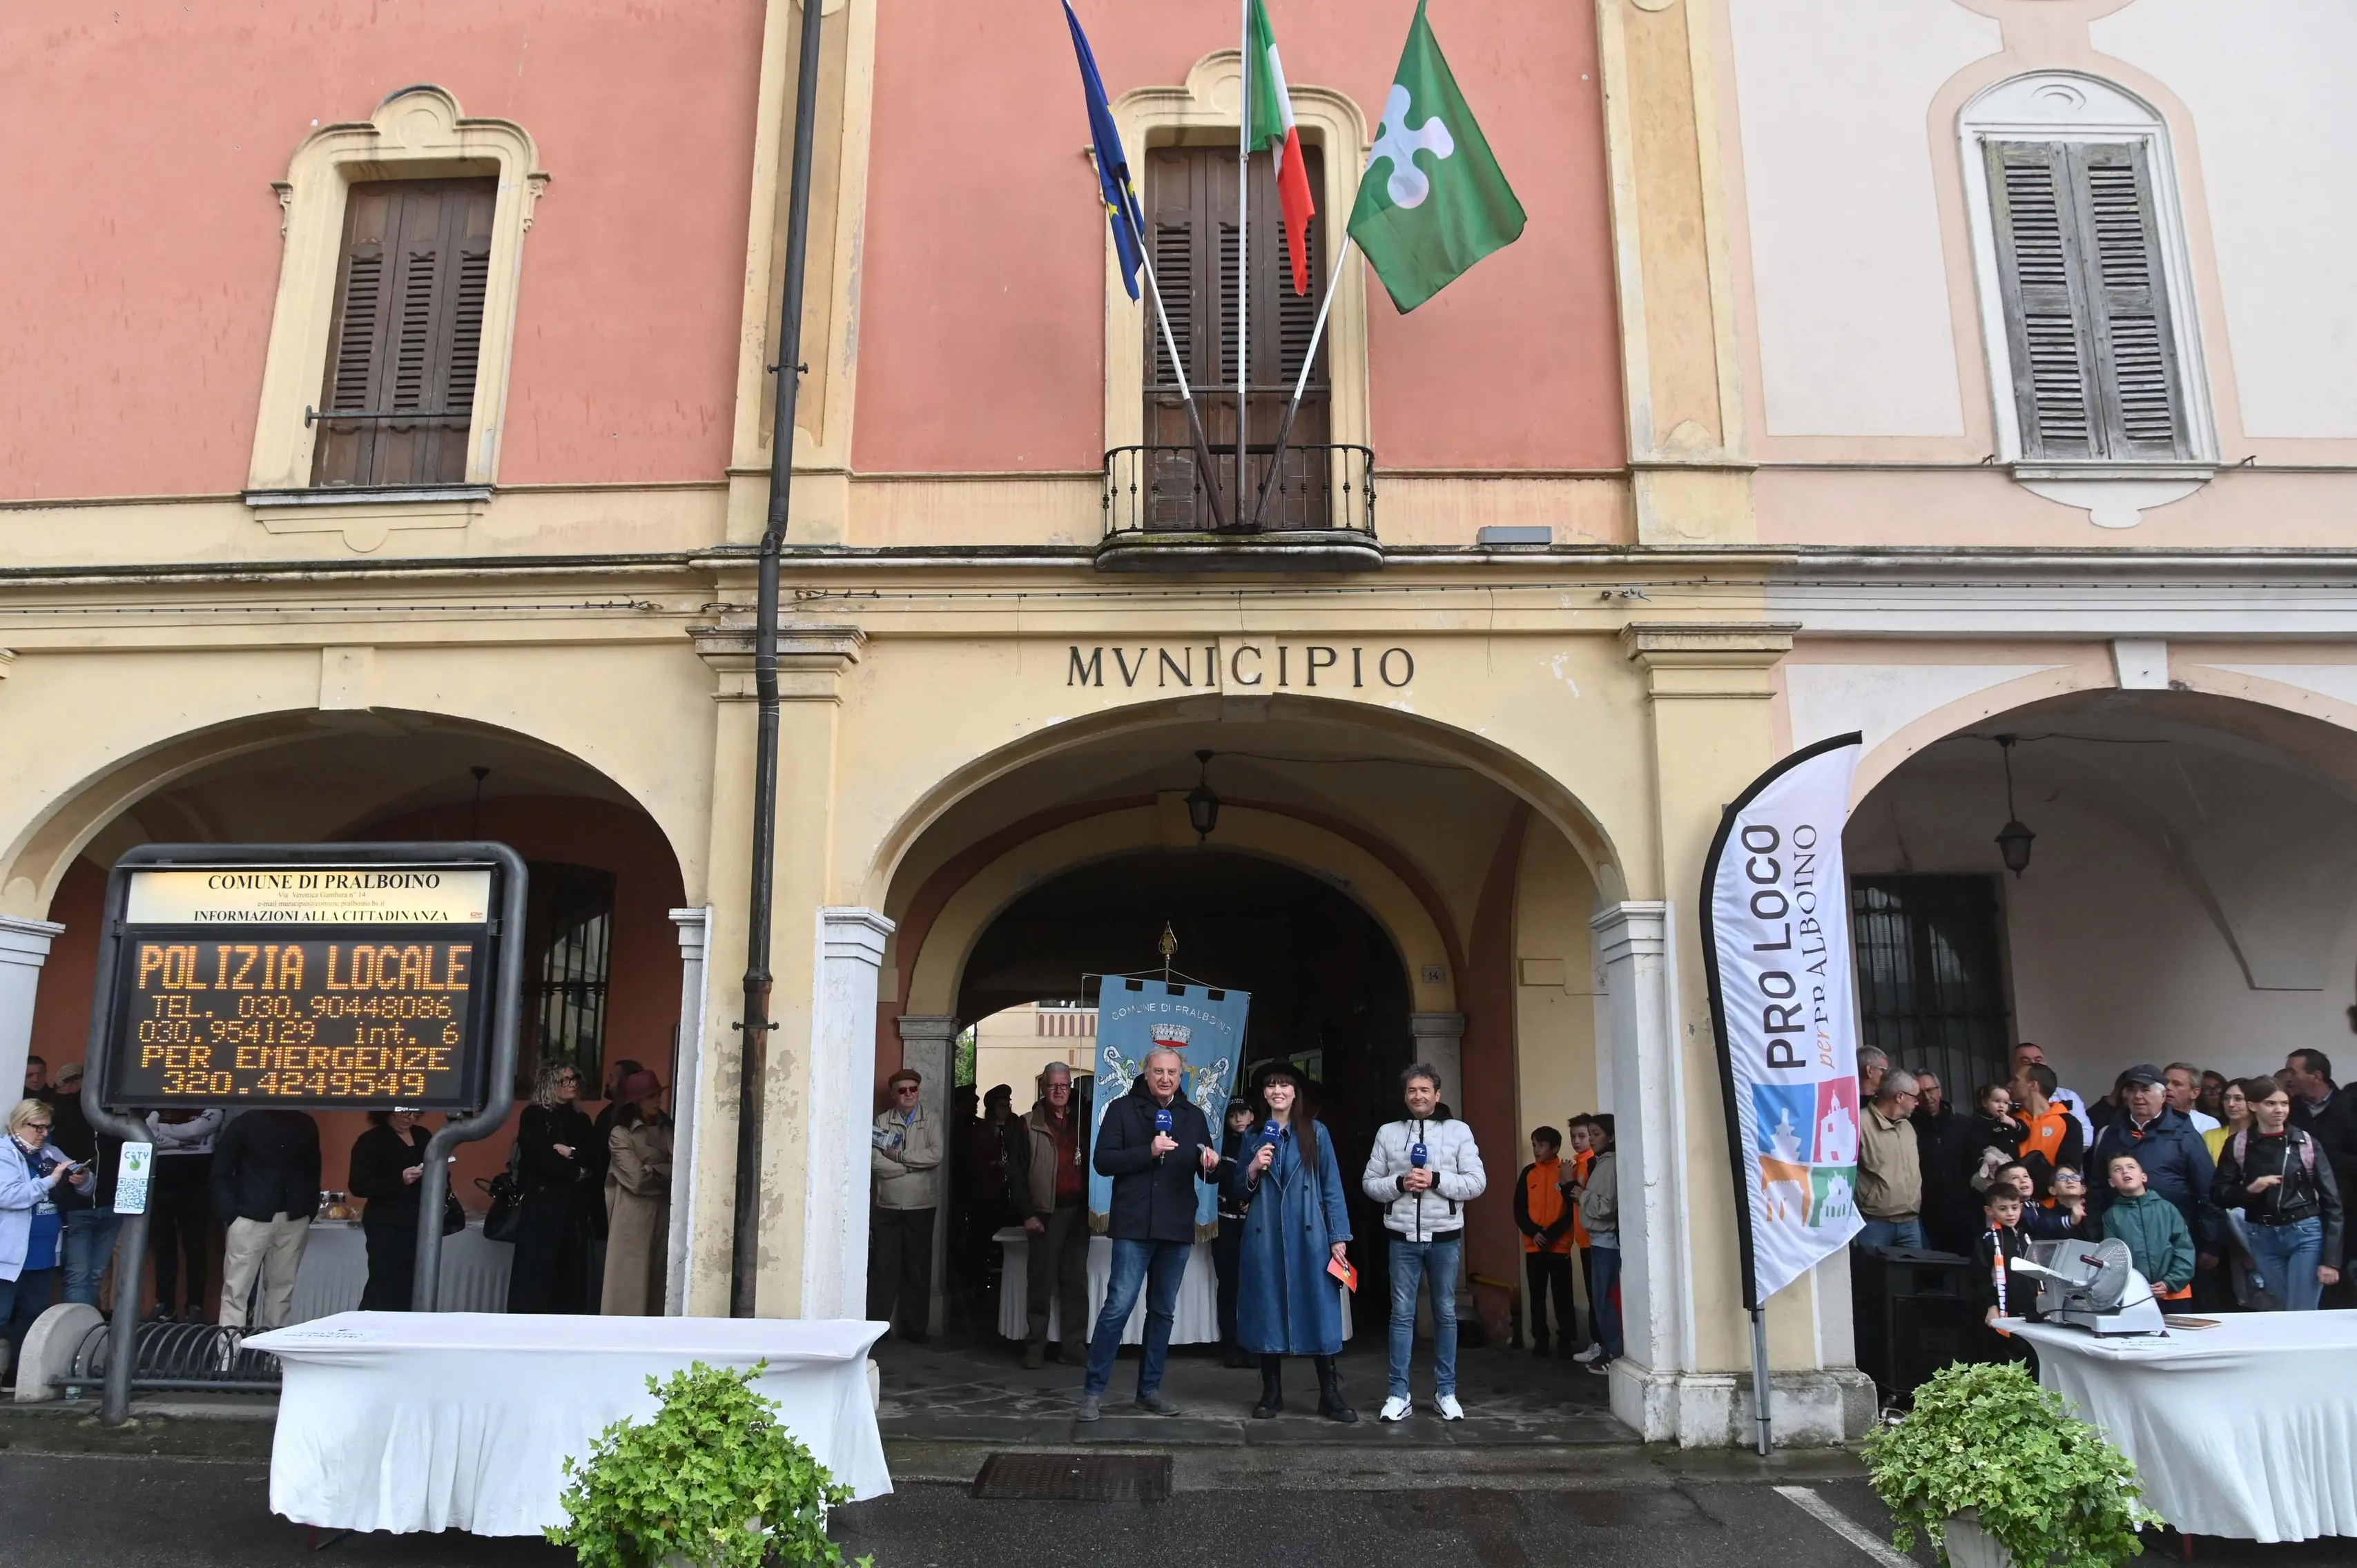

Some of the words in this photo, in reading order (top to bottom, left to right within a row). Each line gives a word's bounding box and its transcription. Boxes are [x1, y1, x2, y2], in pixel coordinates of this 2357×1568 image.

[1066, 645, 1415, 688] MVNICIPIO
[208, 874, 293, 889] COMUNE
[298, 874, 318, 889] DI
[324, 873, 440, 889] PRALBOINO
[1740, 824, 1792, 951] LOCO
[194, 910, 299, 922] INFORMAZIONI
[301, 910, 338, 922] ALLA
[342, 909, 449, 922] CITTADINANZA
[1792, 824, 1830, 1026] PRALBOINO
[138, 945, 305, 990] POLIZIA
[327, 945, 472, 991] LOCALE
[152, 995, 214, 1018] TEL.
[237, 996, 452, 1019] 030.90448086
[1111, 1003, 1156, 1020] COMUNE
[1161, 1003, 1171, 1012] DI
[1174, 1005, 1232, 1035] PRALBOINO
[1758, 971, 1807, 1069] PRO
[138, 1020, 316, 1044] 030.954129
[354, 1021, 417, 1045] int.
[442, 1021, 459, 1045] 6
[141, 1045, 212, 1069] PER
[235, 1045, 452, 1071] EMERGENZE
[162, 1071, 426, 1096] 320.4249549
